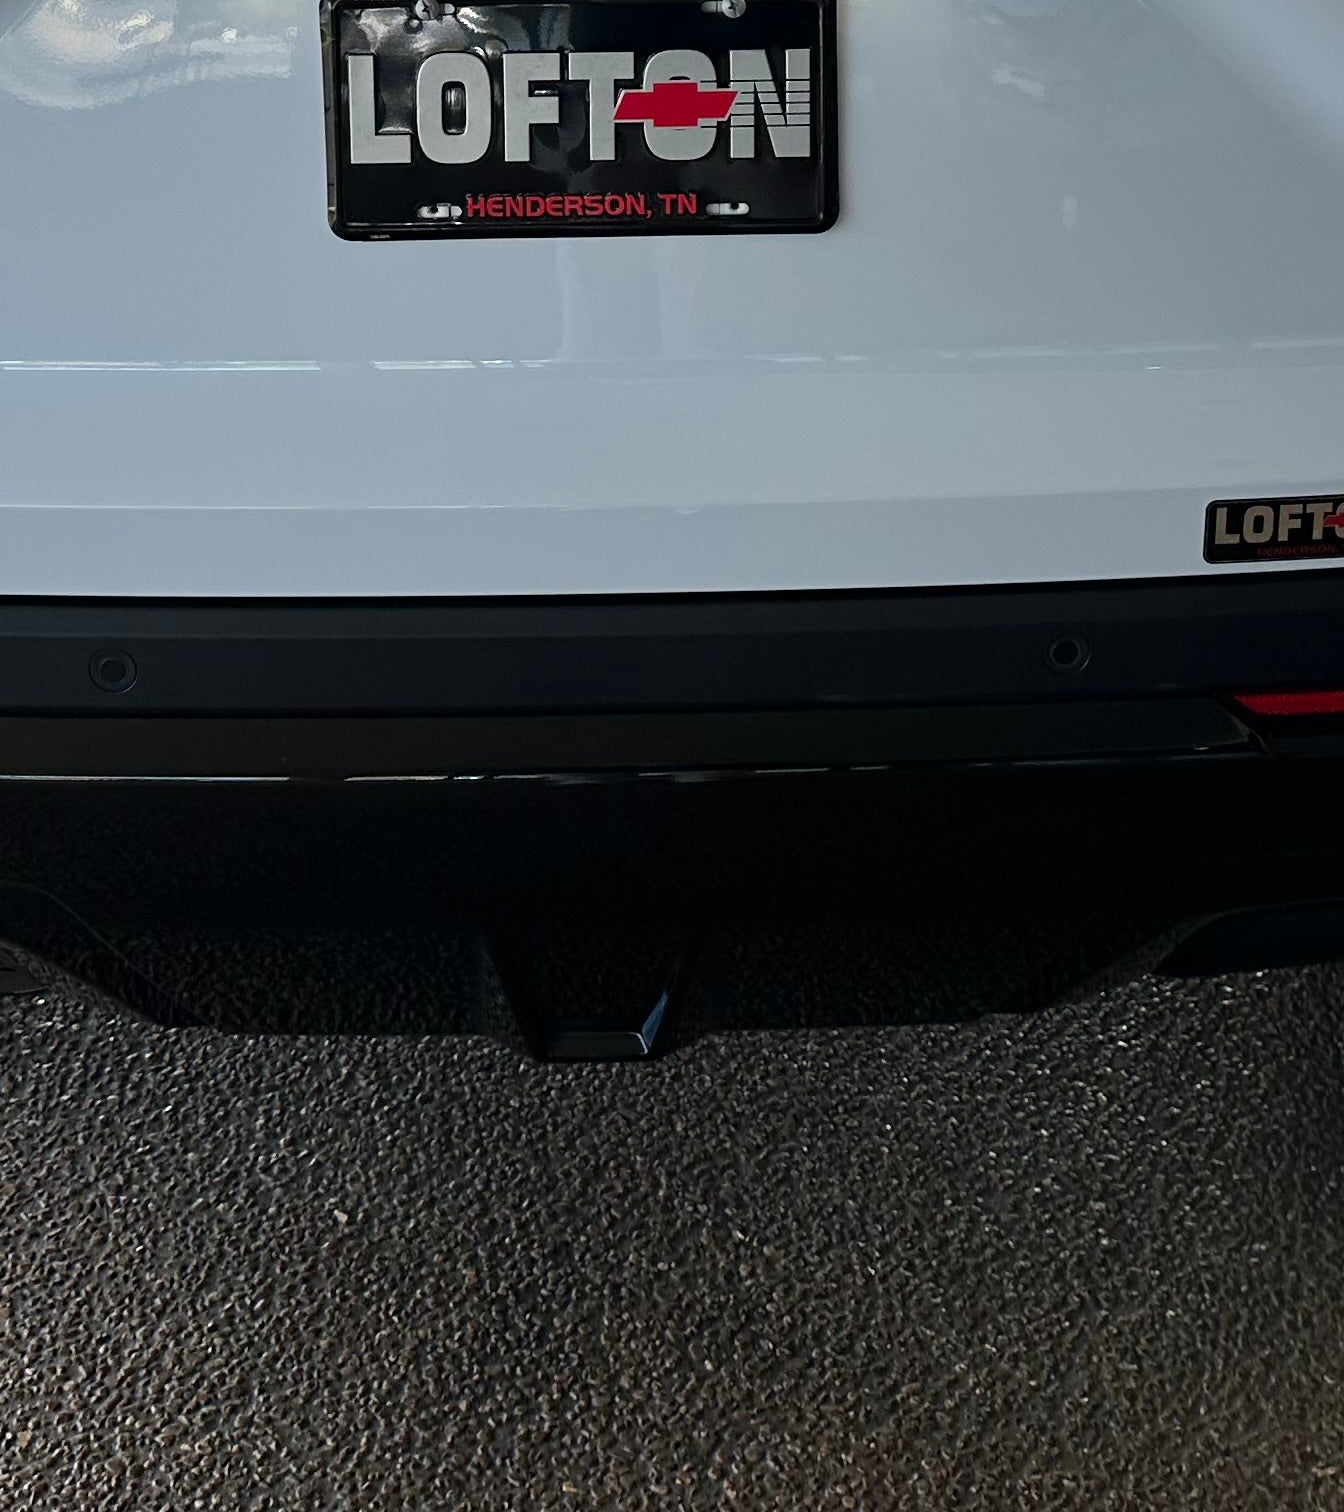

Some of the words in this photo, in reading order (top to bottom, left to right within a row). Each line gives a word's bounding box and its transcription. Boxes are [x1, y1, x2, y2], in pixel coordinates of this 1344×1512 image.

[347, 48, 812, 164] LOFTON
[466, 192, 653, 219] HENDERSON,
[659, 191, 698, 216] TN
